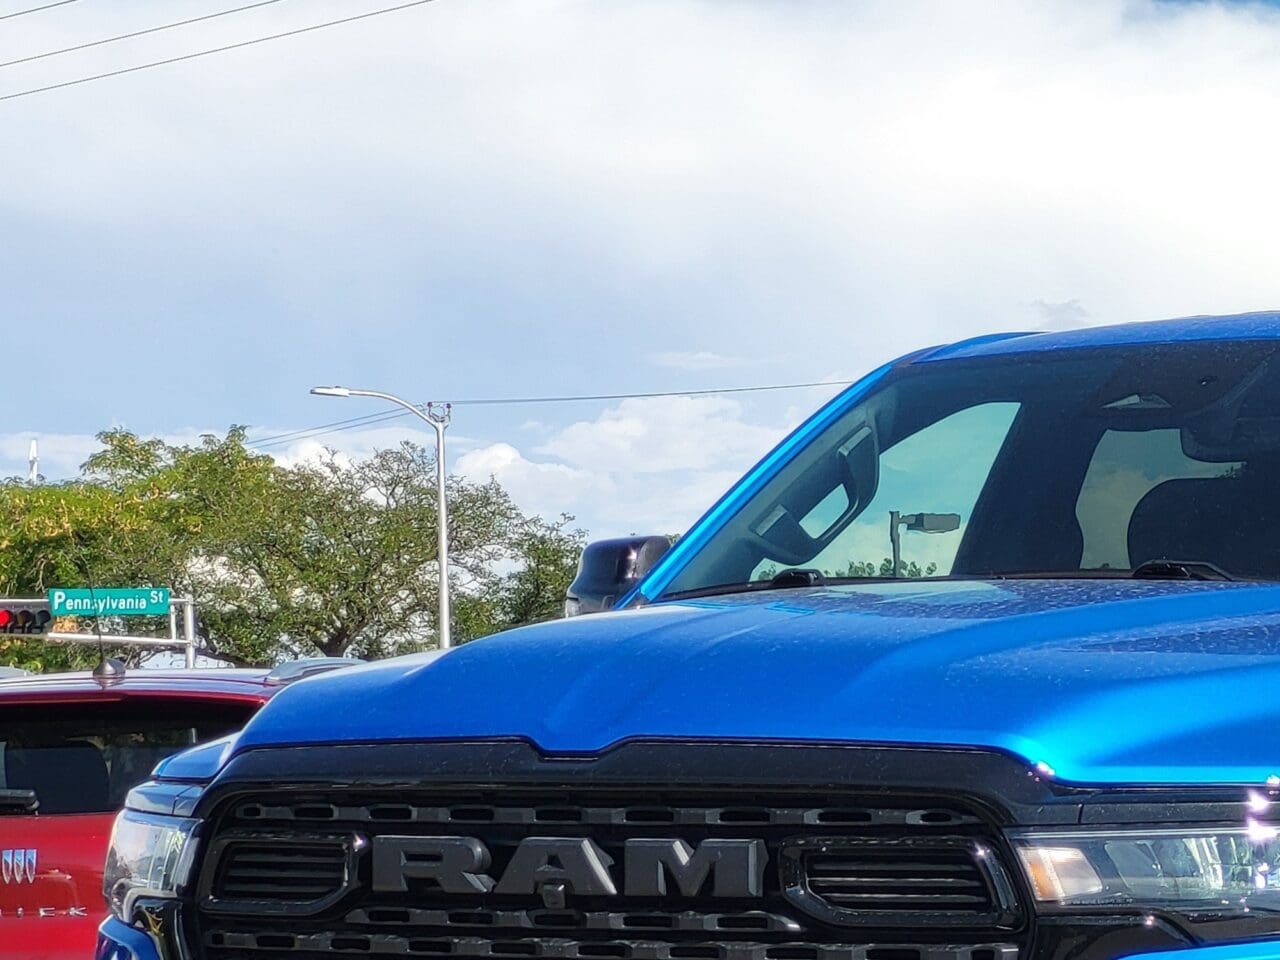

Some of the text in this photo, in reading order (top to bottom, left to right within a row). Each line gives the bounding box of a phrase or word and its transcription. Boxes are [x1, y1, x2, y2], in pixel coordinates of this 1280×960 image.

[151, 591, 164, 604] St
[372, 835, 768, 896] RAM
[0, 906, 88, 919] ICK
